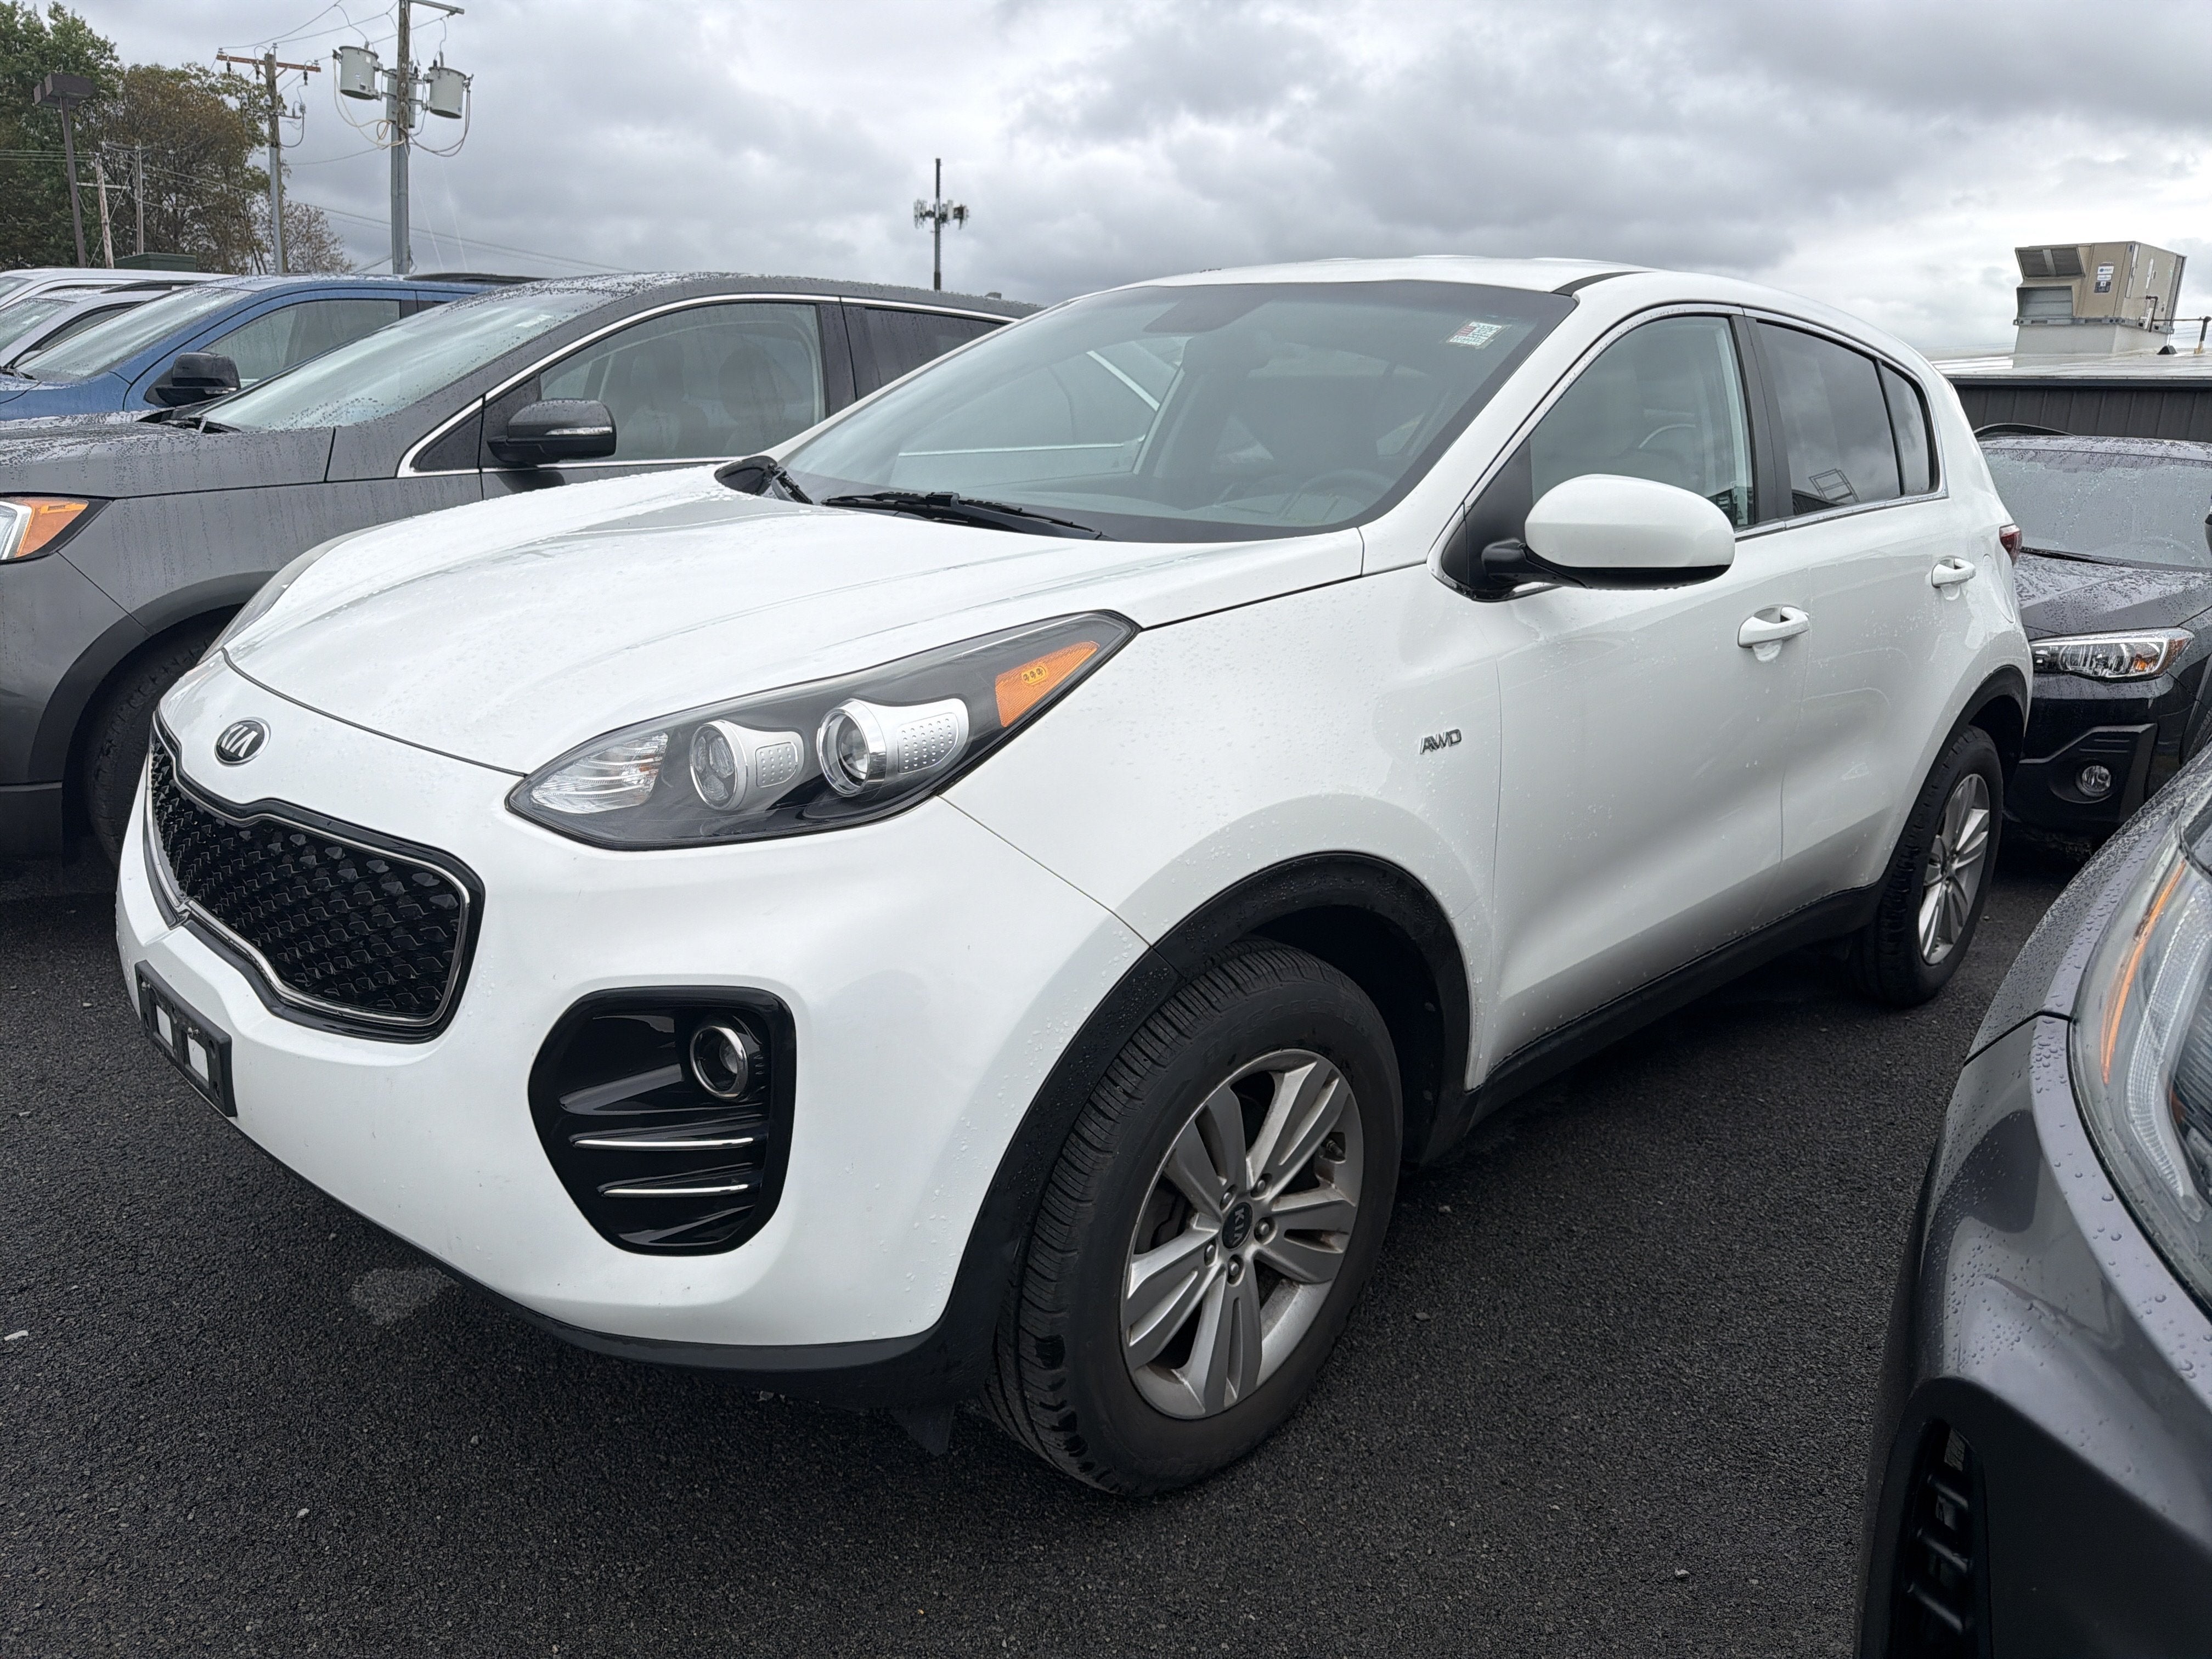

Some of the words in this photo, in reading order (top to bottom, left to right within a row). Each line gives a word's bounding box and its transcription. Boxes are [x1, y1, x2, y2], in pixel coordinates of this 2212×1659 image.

[217, 723, 258, 758] KIA
[1419, 729, 1462, 755] AWD
[1232, 1207, 1244, 1245] KIA
